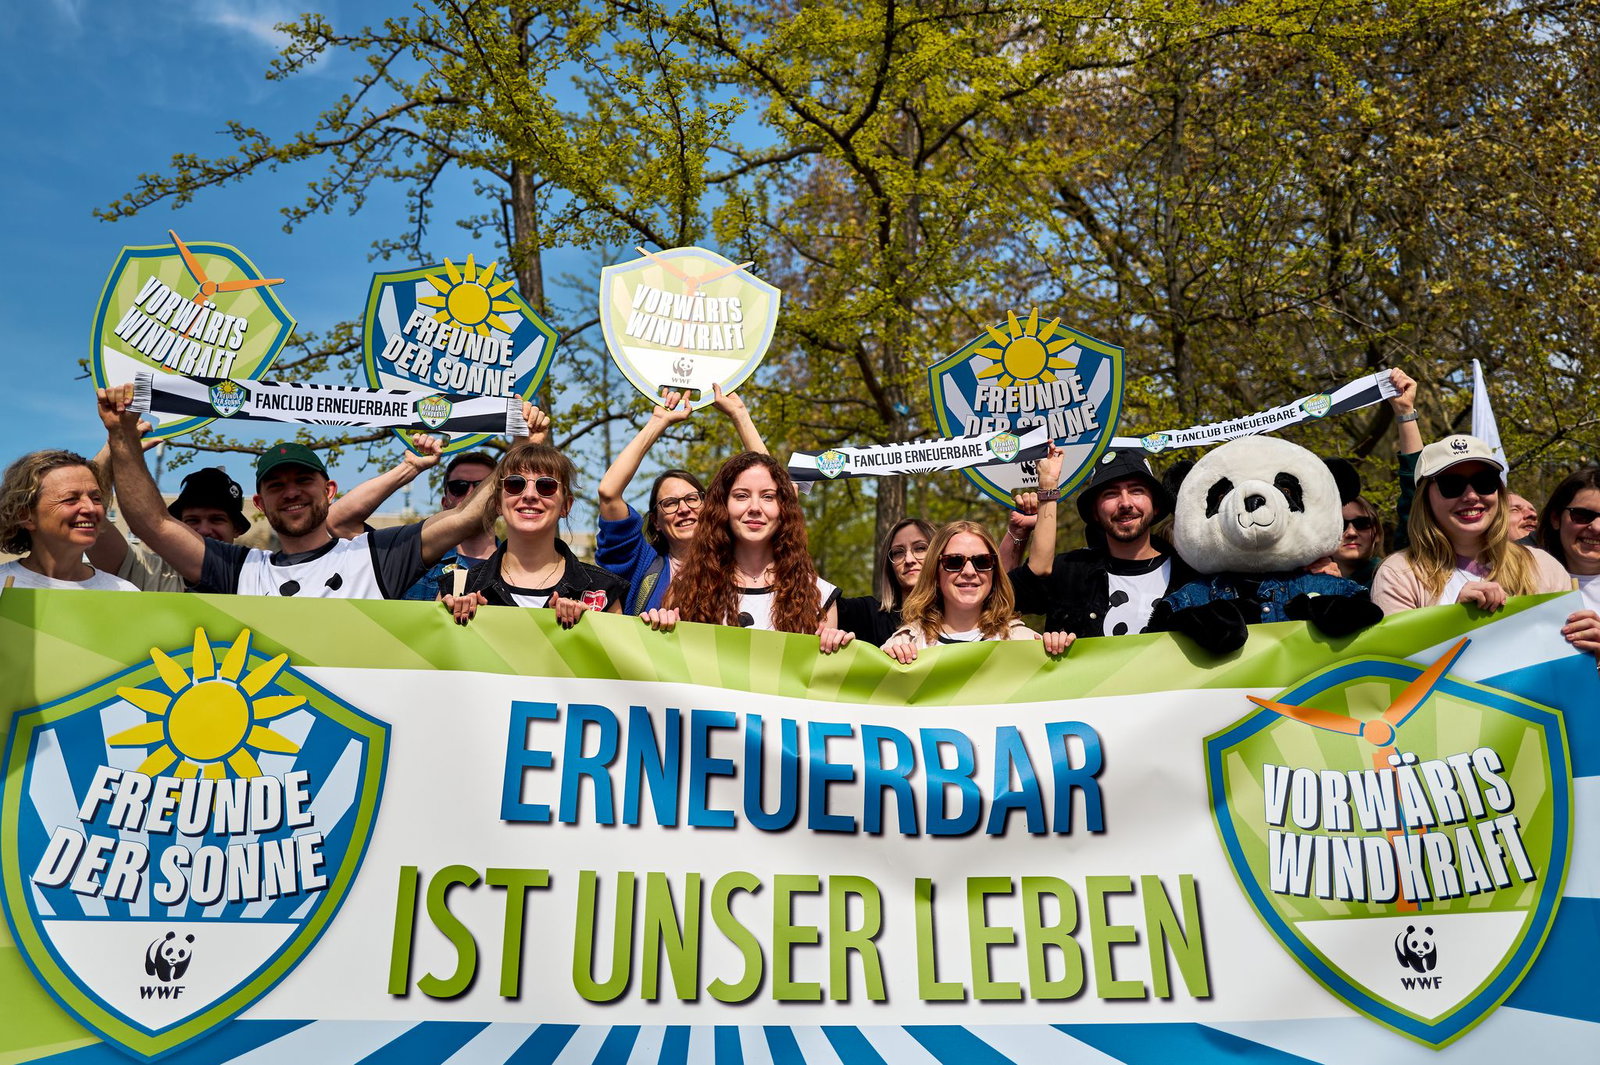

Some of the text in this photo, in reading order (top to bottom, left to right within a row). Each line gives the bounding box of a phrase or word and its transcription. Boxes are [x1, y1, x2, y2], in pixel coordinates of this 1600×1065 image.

[134, 275, 249, 350] VORWÄRTS
[625, 312, 745, 351] WINDKRAFT
[632, 284, 744, 324] VORWÄRTS
[114, 305, 238, 378] WINDKRAFT
[381, 333, 517, 397] DER SONNE
[403, 310, 515, 368] FREUNDE
[256, 393, 314, 412] FANCLUB
[316, 397, 408, 417] ERNEUERBARE
[671, 377, 692, 385] WWF
[974, 374, 1088, 414] FREUNDE
[1176, 408, 1296, 443] FANCLUB ERNEUERBARE
[854, 451, 902, 468] FANCLUB
[905, 443, 983, 463] ERNEUERBARE
[500, 700, 1106, 836] ERNEUERBAR
[1263, 747, 1514, 831] VORWÄRTS
[77, 765, 315, 836] FREUNDE
[32, 825, 329, 905] DER SONNE
[1268, 814, 1536, 903] WINDKRAFT
[387, 865, 1211, 1003] IST UNSER LEBEN
[140, 986, 186, 999] WWF
[1400, 976, 1443, 990] WWF
